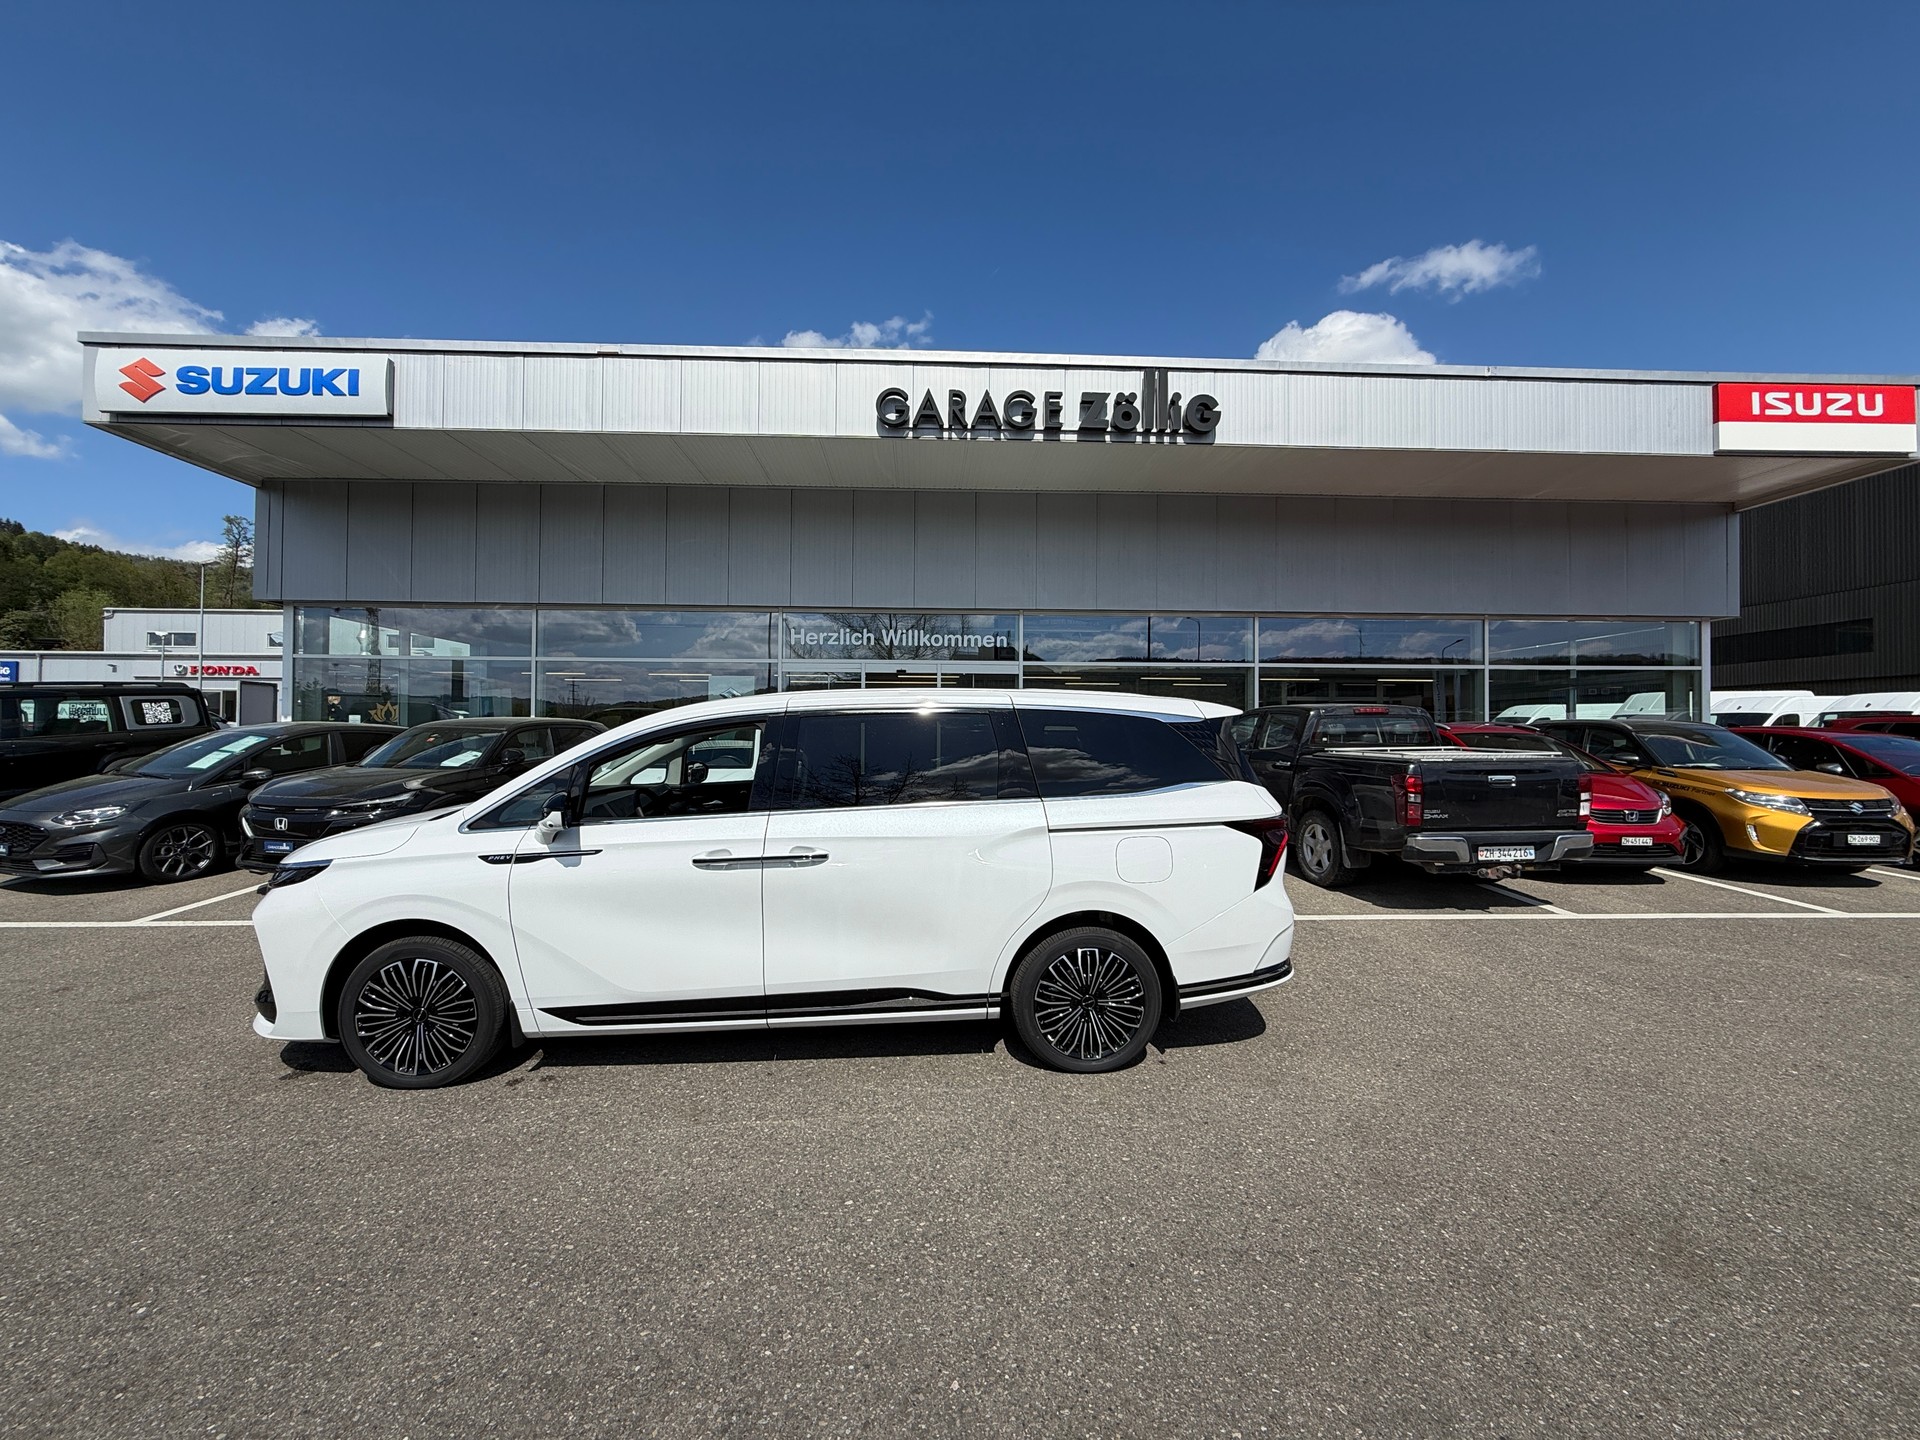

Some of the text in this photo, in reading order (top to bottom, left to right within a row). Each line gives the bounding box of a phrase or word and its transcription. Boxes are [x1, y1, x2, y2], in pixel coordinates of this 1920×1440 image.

[175, 365, 359, 396] SUZUKI
[876, 387, 1064, 431] GARAGE
[1751, 391, 1884, 417] ISUZU
[790, 628, 1008, 648] Herzlich Willkommen
[189, 665, 260, 676] HONDA
